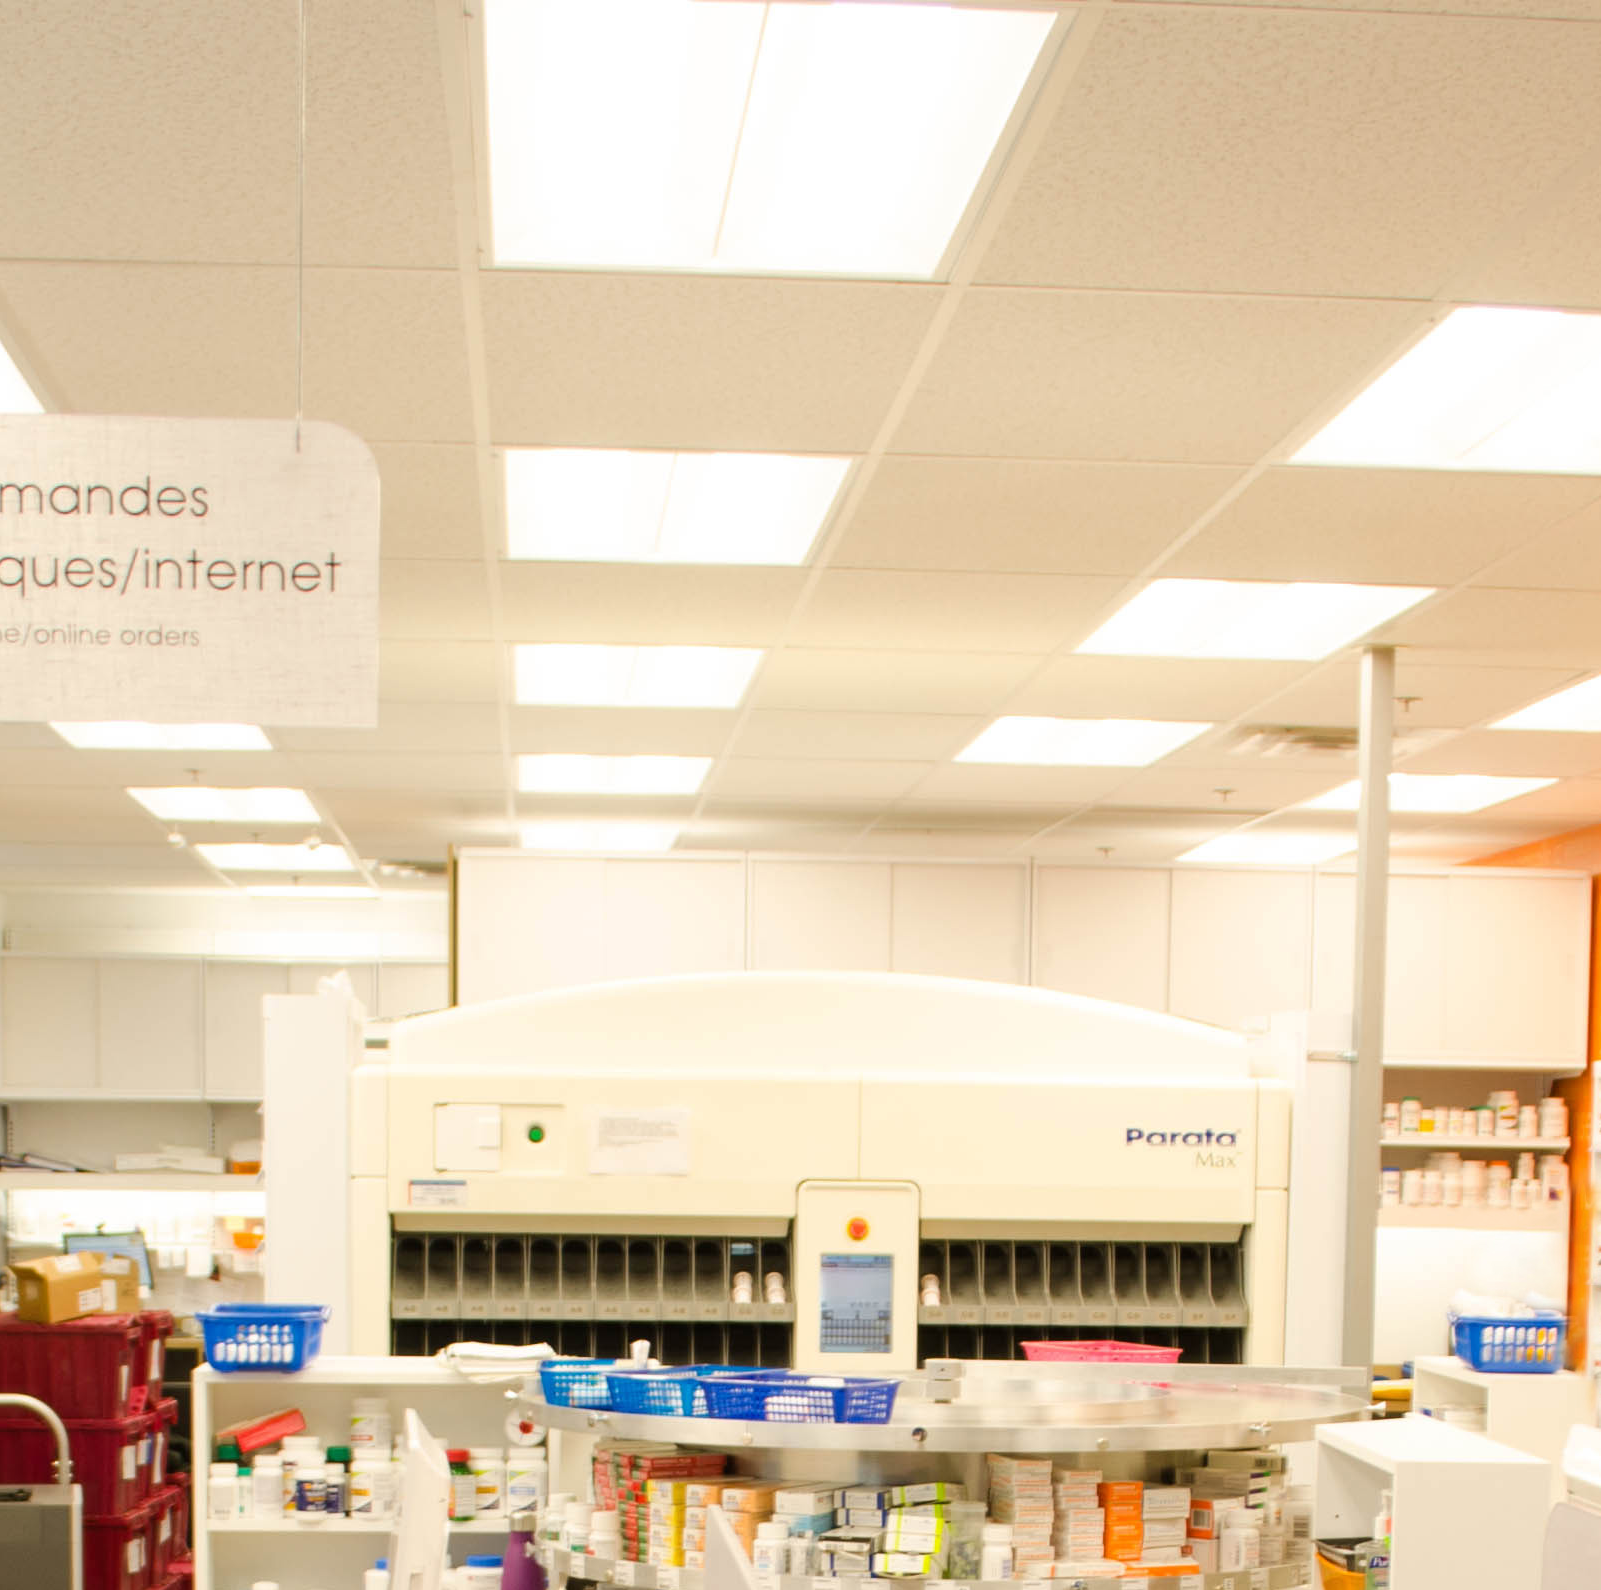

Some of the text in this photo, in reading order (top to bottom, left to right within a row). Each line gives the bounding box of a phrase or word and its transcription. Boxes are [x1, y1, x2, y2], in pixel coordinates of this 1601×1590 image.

[120, 624, 200, 647] orders
[1126, 1128, 1237, 1147] Parata
[1196, 1152, 1236, 1168] Max
